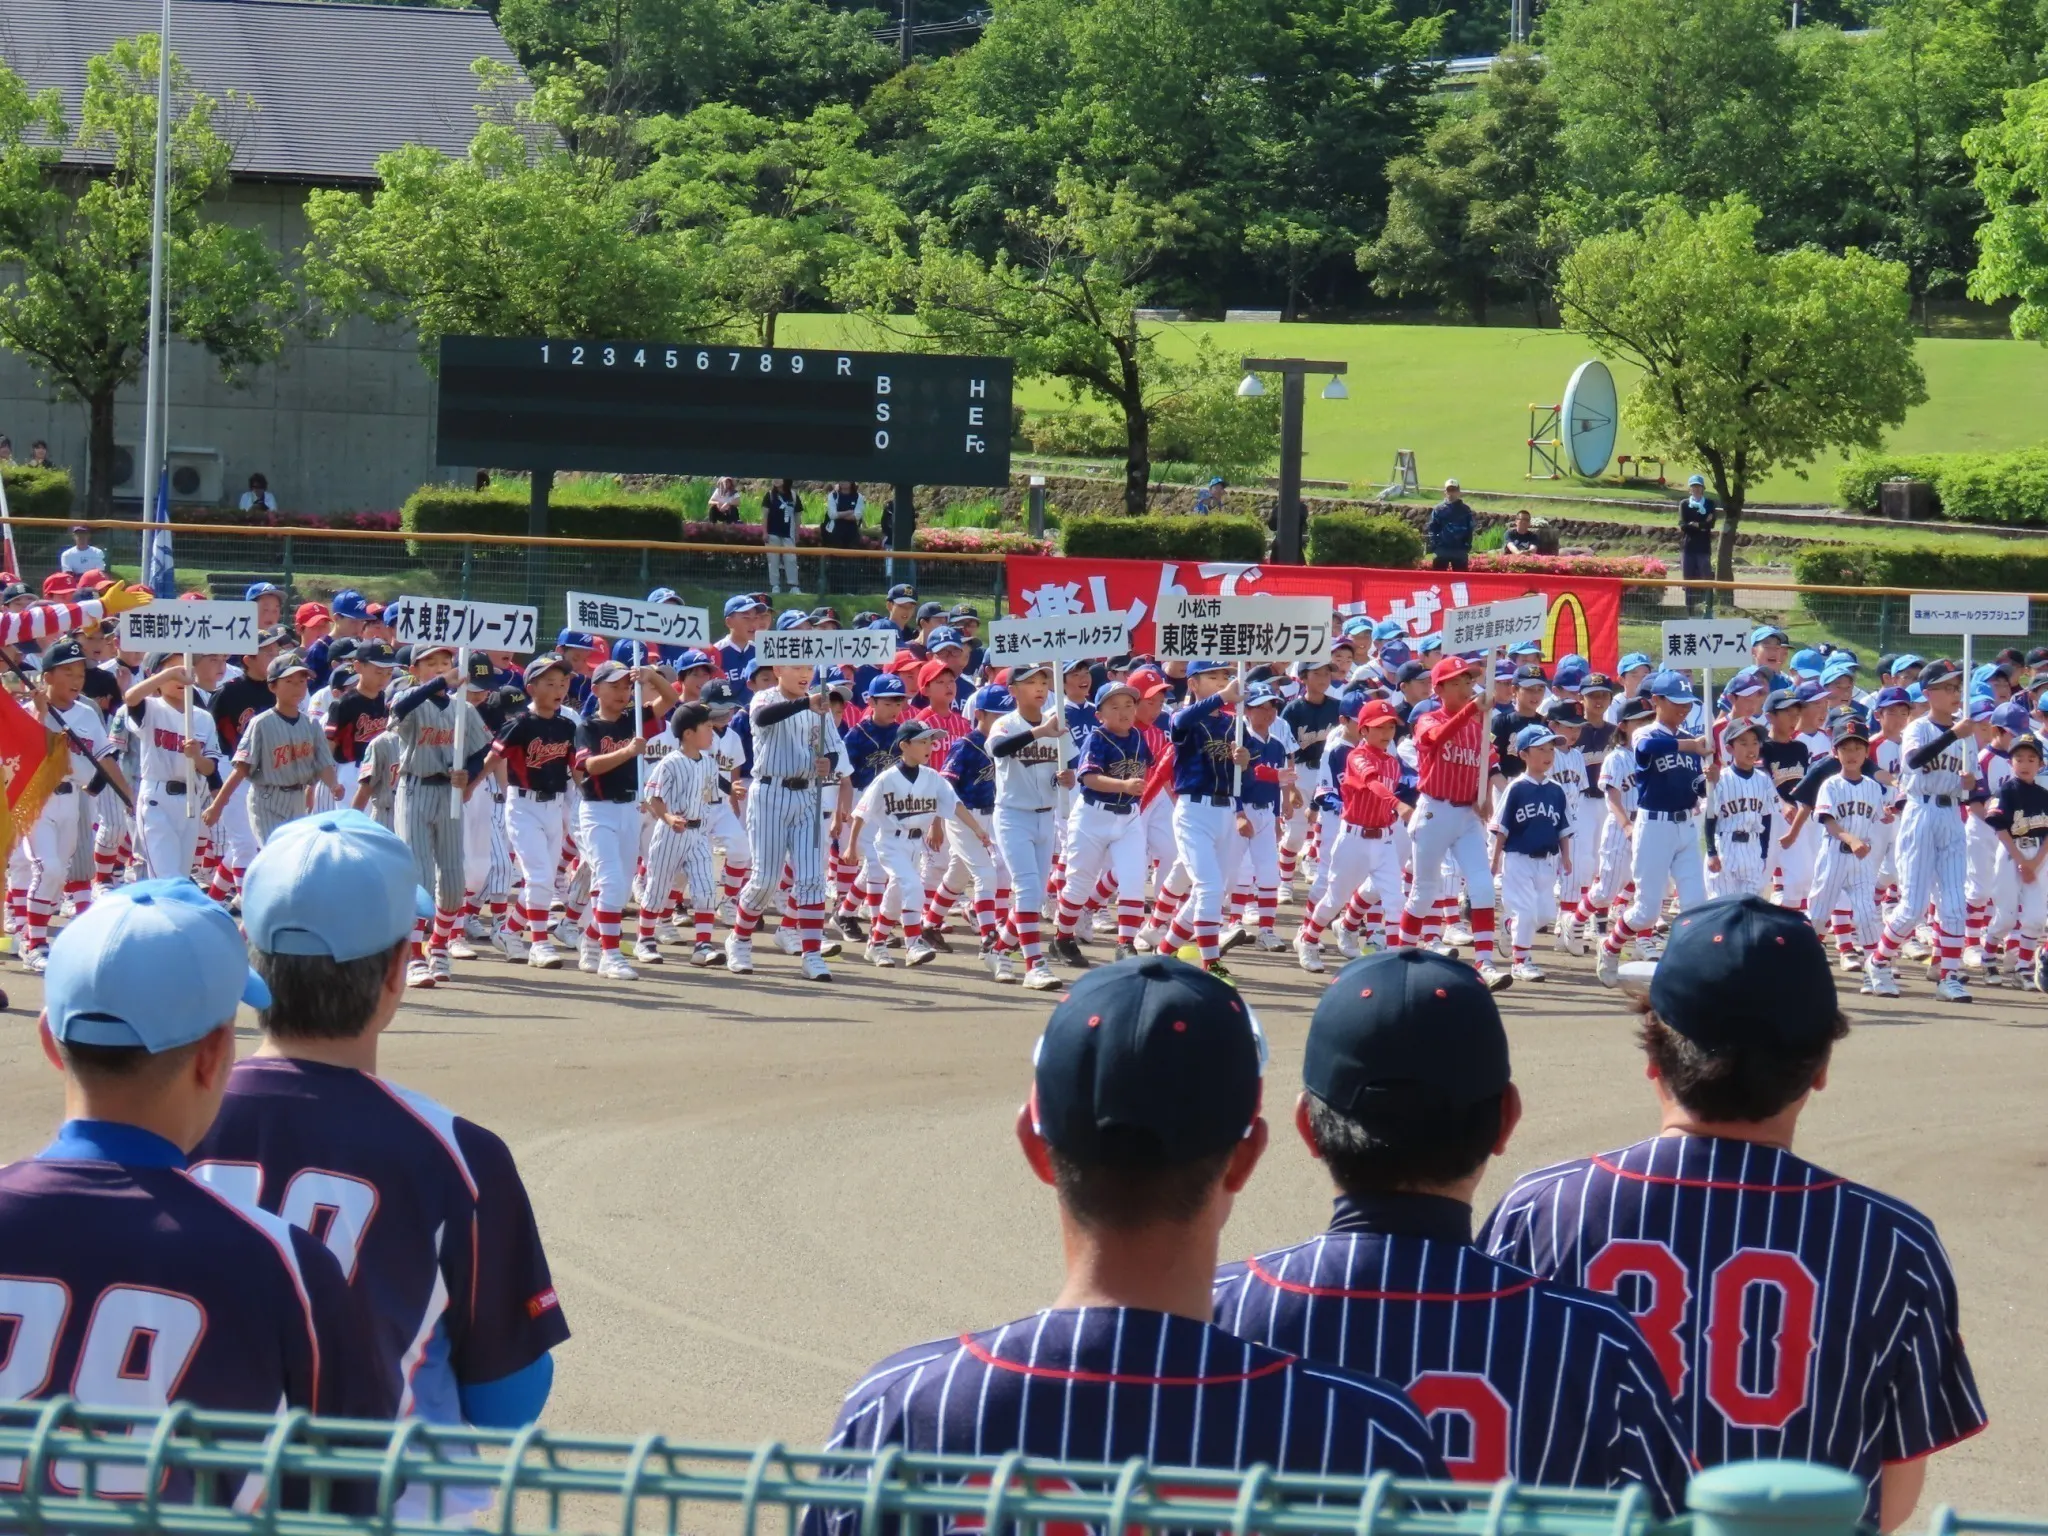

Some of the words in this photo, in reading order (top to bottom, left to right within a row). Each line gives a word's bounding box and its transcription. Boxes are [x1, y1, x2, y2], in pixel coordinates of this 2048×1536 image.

[540, 345, 549, 364] 1
[571, 346, 584, 365] 2
[603, 347, 616, 366] 3
[634, 349, 646, 367] 4
[665, 350, 678, 369] 5
[696, 351, 709, 370] 6
[728, 353, 740, 371] 7
[759, 354, 772, 372] 8
[791, 356, 804, 373] 9
[837, 357, 851, 375] R
[877, 376, 891, 394] B
[970, 379, 985, 398] H
[876, 403, 890, 421] S
[969, 407, 983, 425] E
[966, 435, 985, 453] Fc
[578, 600, 702, 640] 輪島フェニックス
[1177, 598, 1222, 618] 小松市
[129, 613, 251, 640] 西南部サンボーイズ
[400, 600, 534, 647] 木曳野ブレーブス
[1454, 612, 1541, 644] 志賀学童野球クラブ
[995, 624, 1123, 654] 宝達ベースボールクラブ
[1161, 622, 1329, 657] 東陵学童野球クラブ
[1668, 632, 1747, 656] 東湊ベアーズ
[1586, 1238, 1819, 1430] 30
